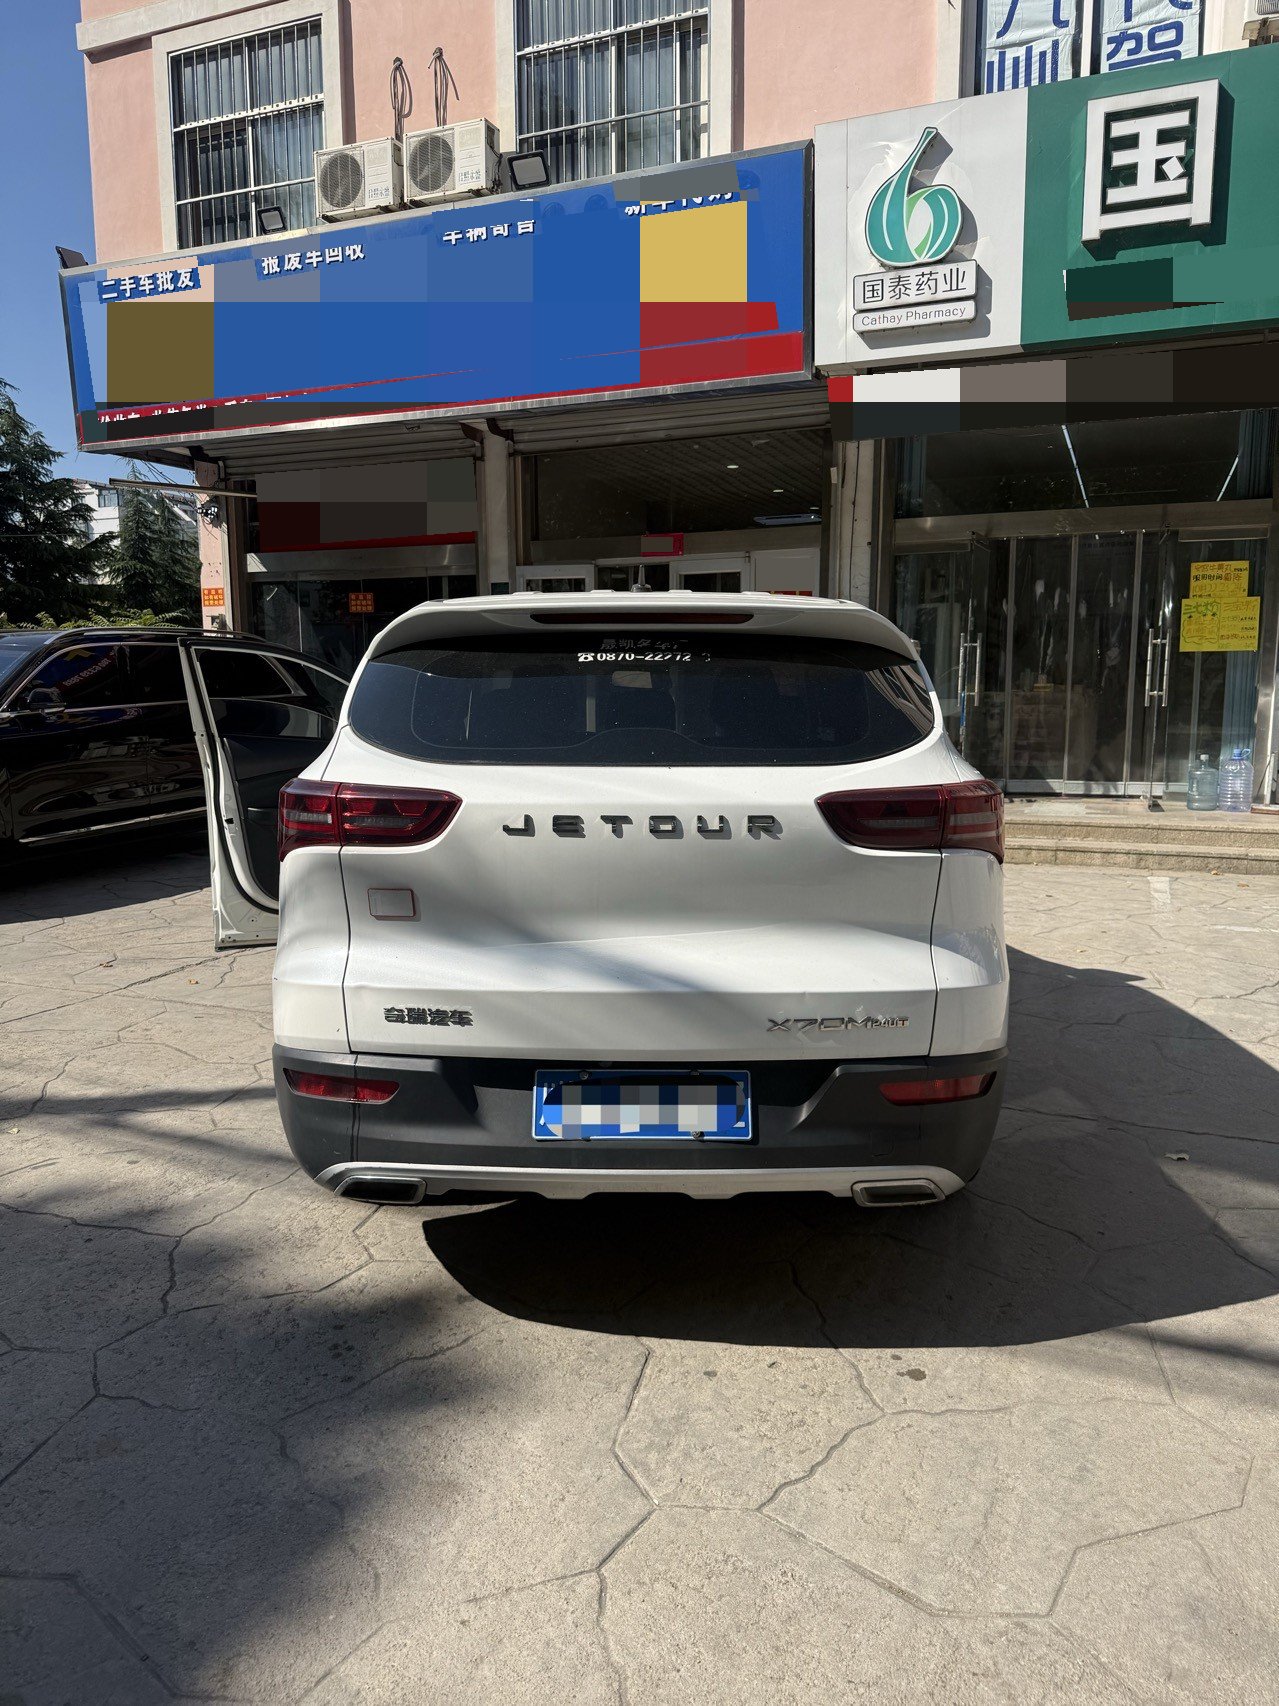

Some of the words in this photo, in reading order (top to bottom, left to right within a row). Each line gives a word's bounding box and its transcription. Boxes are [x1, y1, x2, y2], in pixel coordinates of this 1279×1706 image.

[1082, 79, 1219, 240] 国
[102, 268, 194, 299] 二手车批发
[863, 268, 967, 303] 国泰药业
[861, 314, 902, 326] Cathay
[906, 307, 966, 321] Pharmacy
[502, 814, 782, 840] JETOUR
[383, 1006, 474, 1027] 奇瑞汽车
[767, 1016, 872, 1031] X70M
